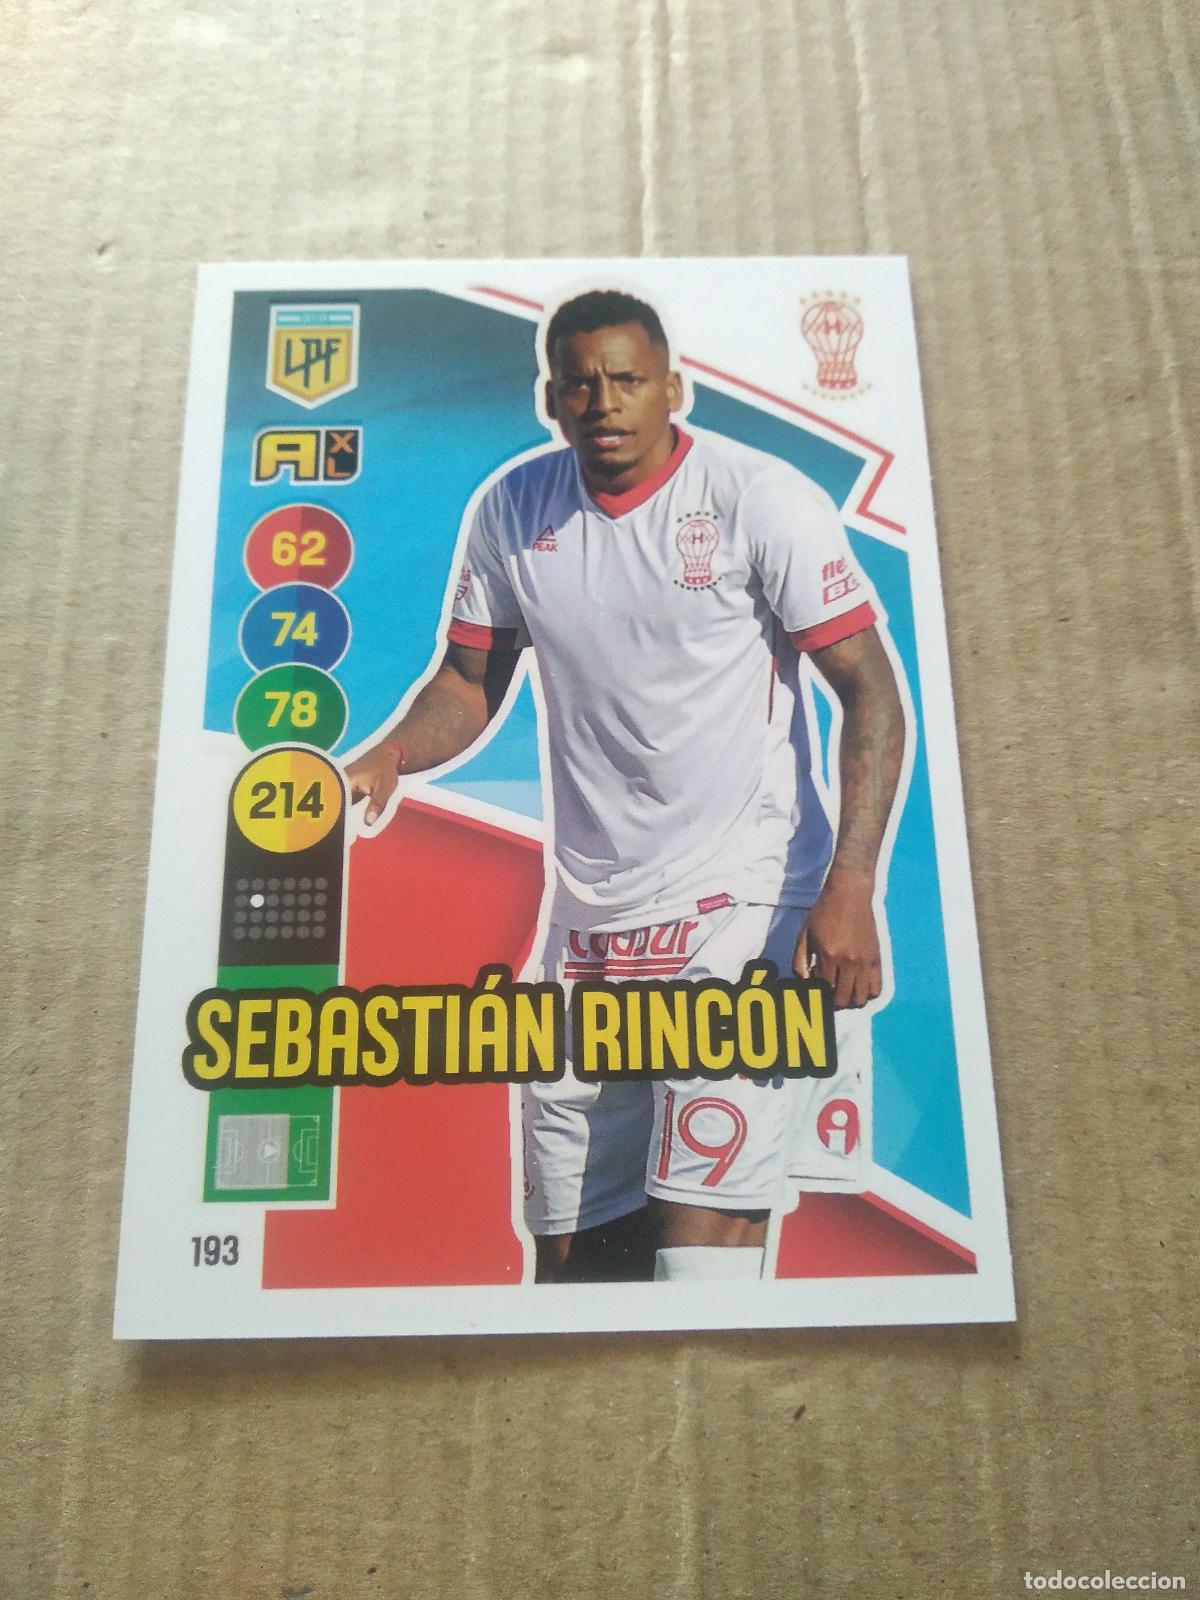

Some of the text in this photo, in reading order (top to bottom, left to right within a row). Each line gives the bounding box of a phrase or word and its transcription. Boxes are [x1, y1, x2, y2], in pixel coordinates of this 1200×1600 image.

[271, 530, 327, 567] 62
[532, 541, 558, 552] PEAK
[271, 611, 318, 647] 74
[264, 690, 318, 728] 78
[249, 780, 324, 819] 214
[192, 969, 828, 1081] SEBASTIÁN RINCÓN
[657, 1090, 748, 1187] 19
[191, 1235, 239, 1267] 193
